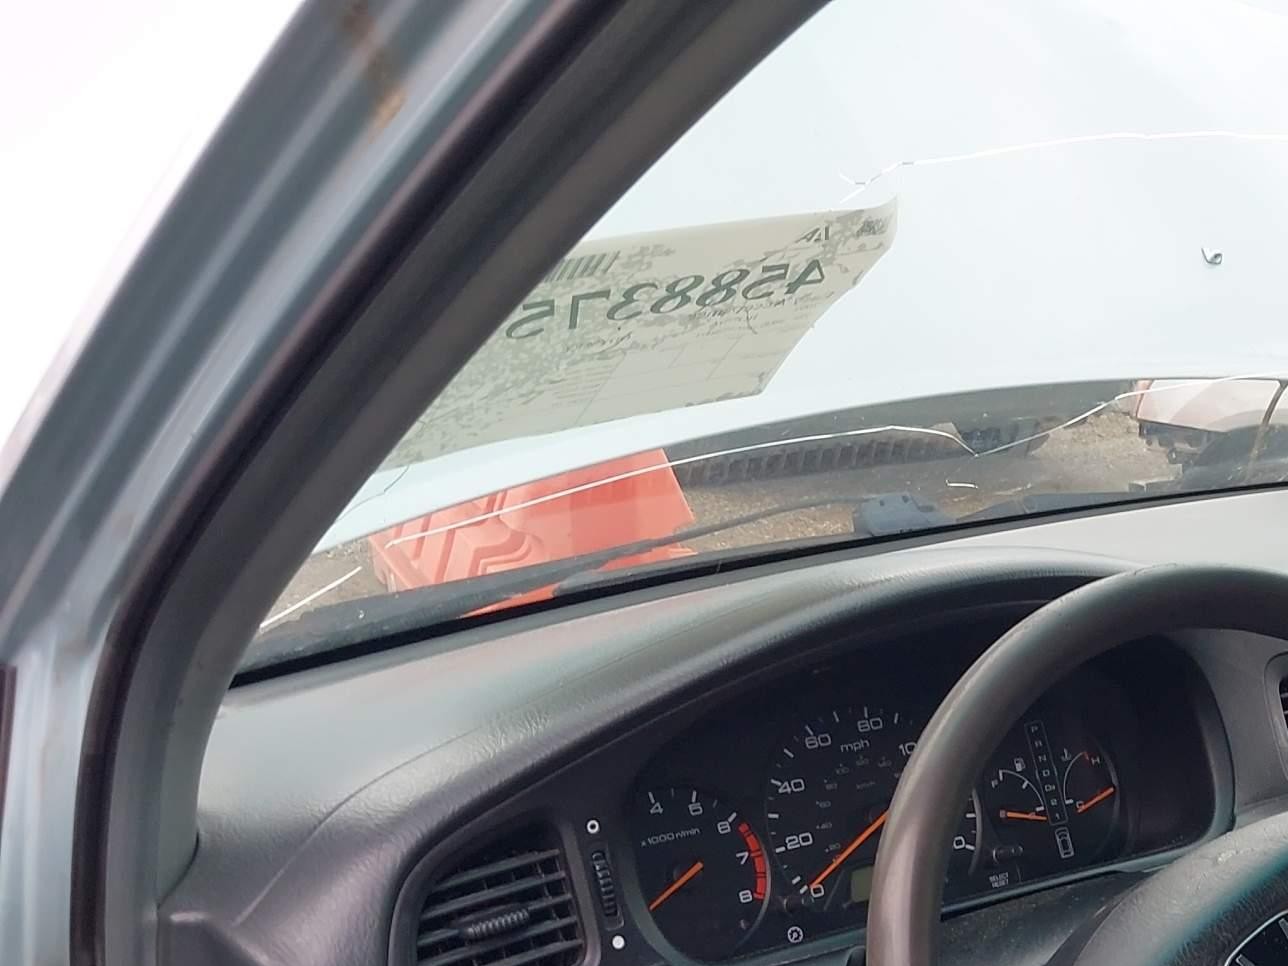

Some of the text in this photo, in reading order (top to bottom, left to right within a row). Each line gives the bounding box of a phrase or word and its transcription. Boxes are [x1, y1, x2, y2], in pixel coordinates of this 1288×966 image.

[856, 716, 884, 733] 80
[804, 733, 832, 750] 60
[840, 738, 870, 753] mph
[898, 741, 918, 757] 10
[1091, 756, 1101, 766] H
[778, 778, 805, 795] 40
[649, 801, 664, 815] 4
[688, 802, 704, 816] 5
[785, 831, 814, 850] 20
[735, 851, 750, 866] 7
[738, 888, 753, 904] 8
[810, 884, 825, 899] 0
